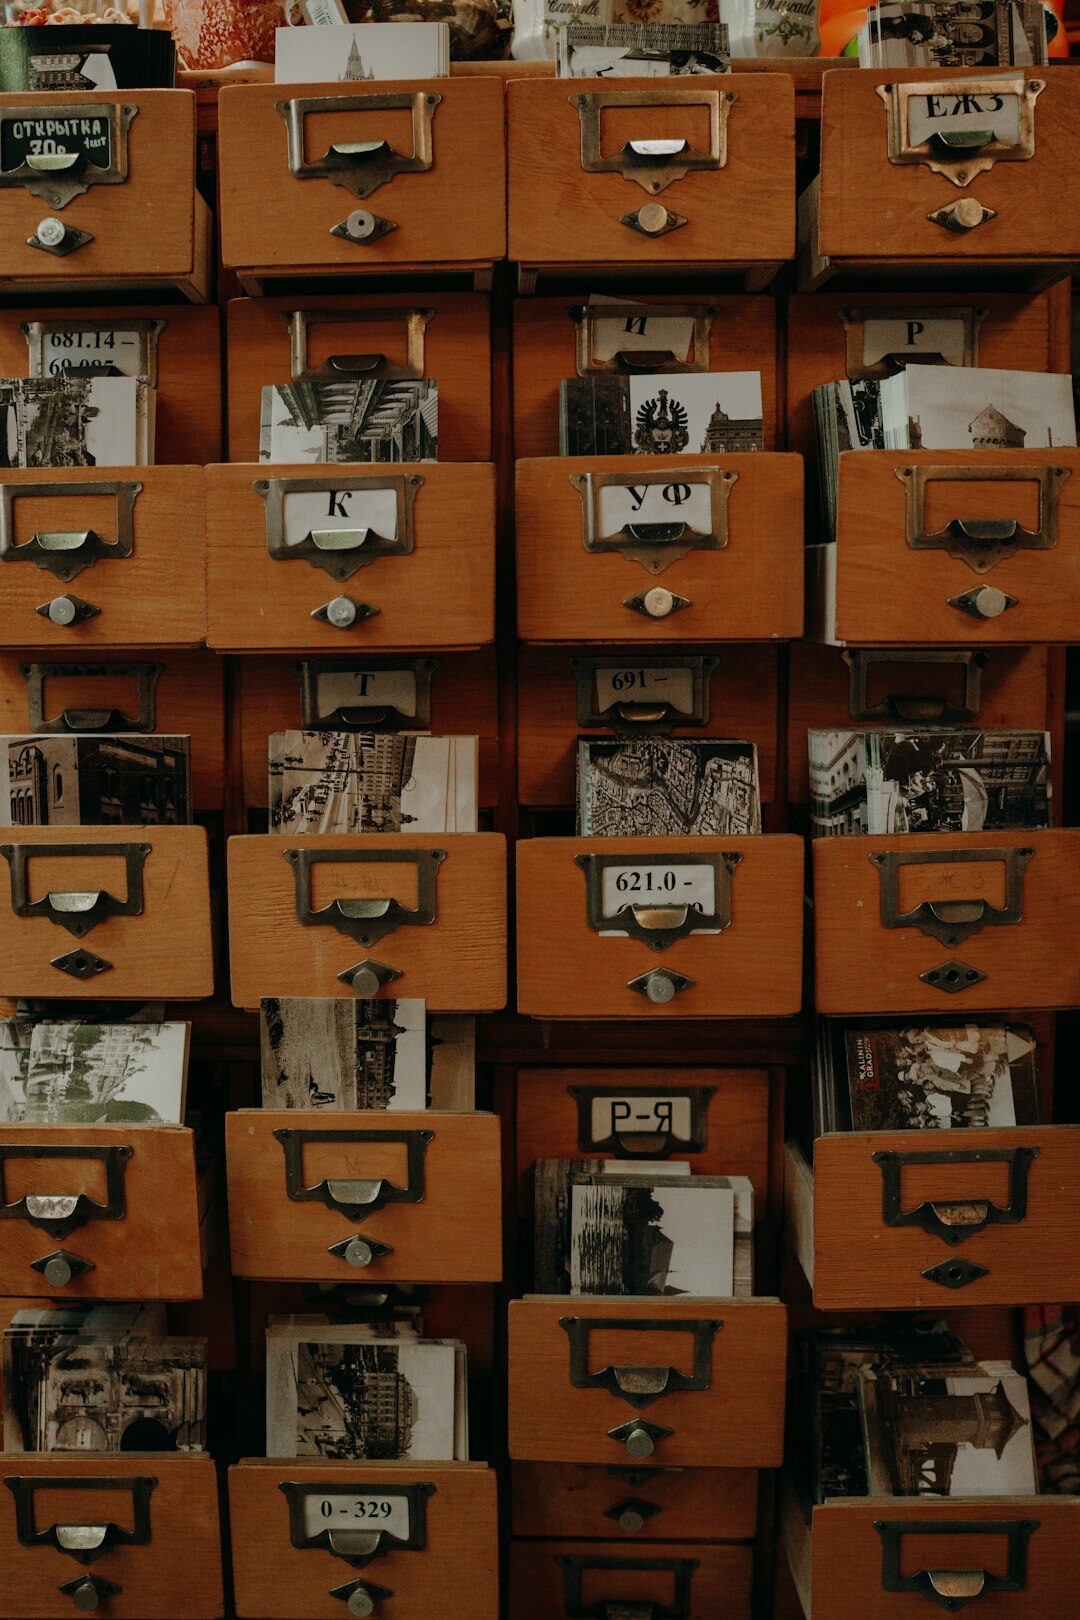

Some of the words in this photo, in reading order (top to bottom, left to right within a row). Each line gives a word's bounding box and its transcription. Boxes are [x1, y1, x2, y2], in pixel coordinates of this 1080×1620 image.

[13, 119, 102, 139] ОТКРЫТКА
[51, 331, 115, 348] 681.14
[612, 669, 647, 690] 691
[321, 1500, 332, 1518] 0
[354, 1501, 392, 1518] 329
